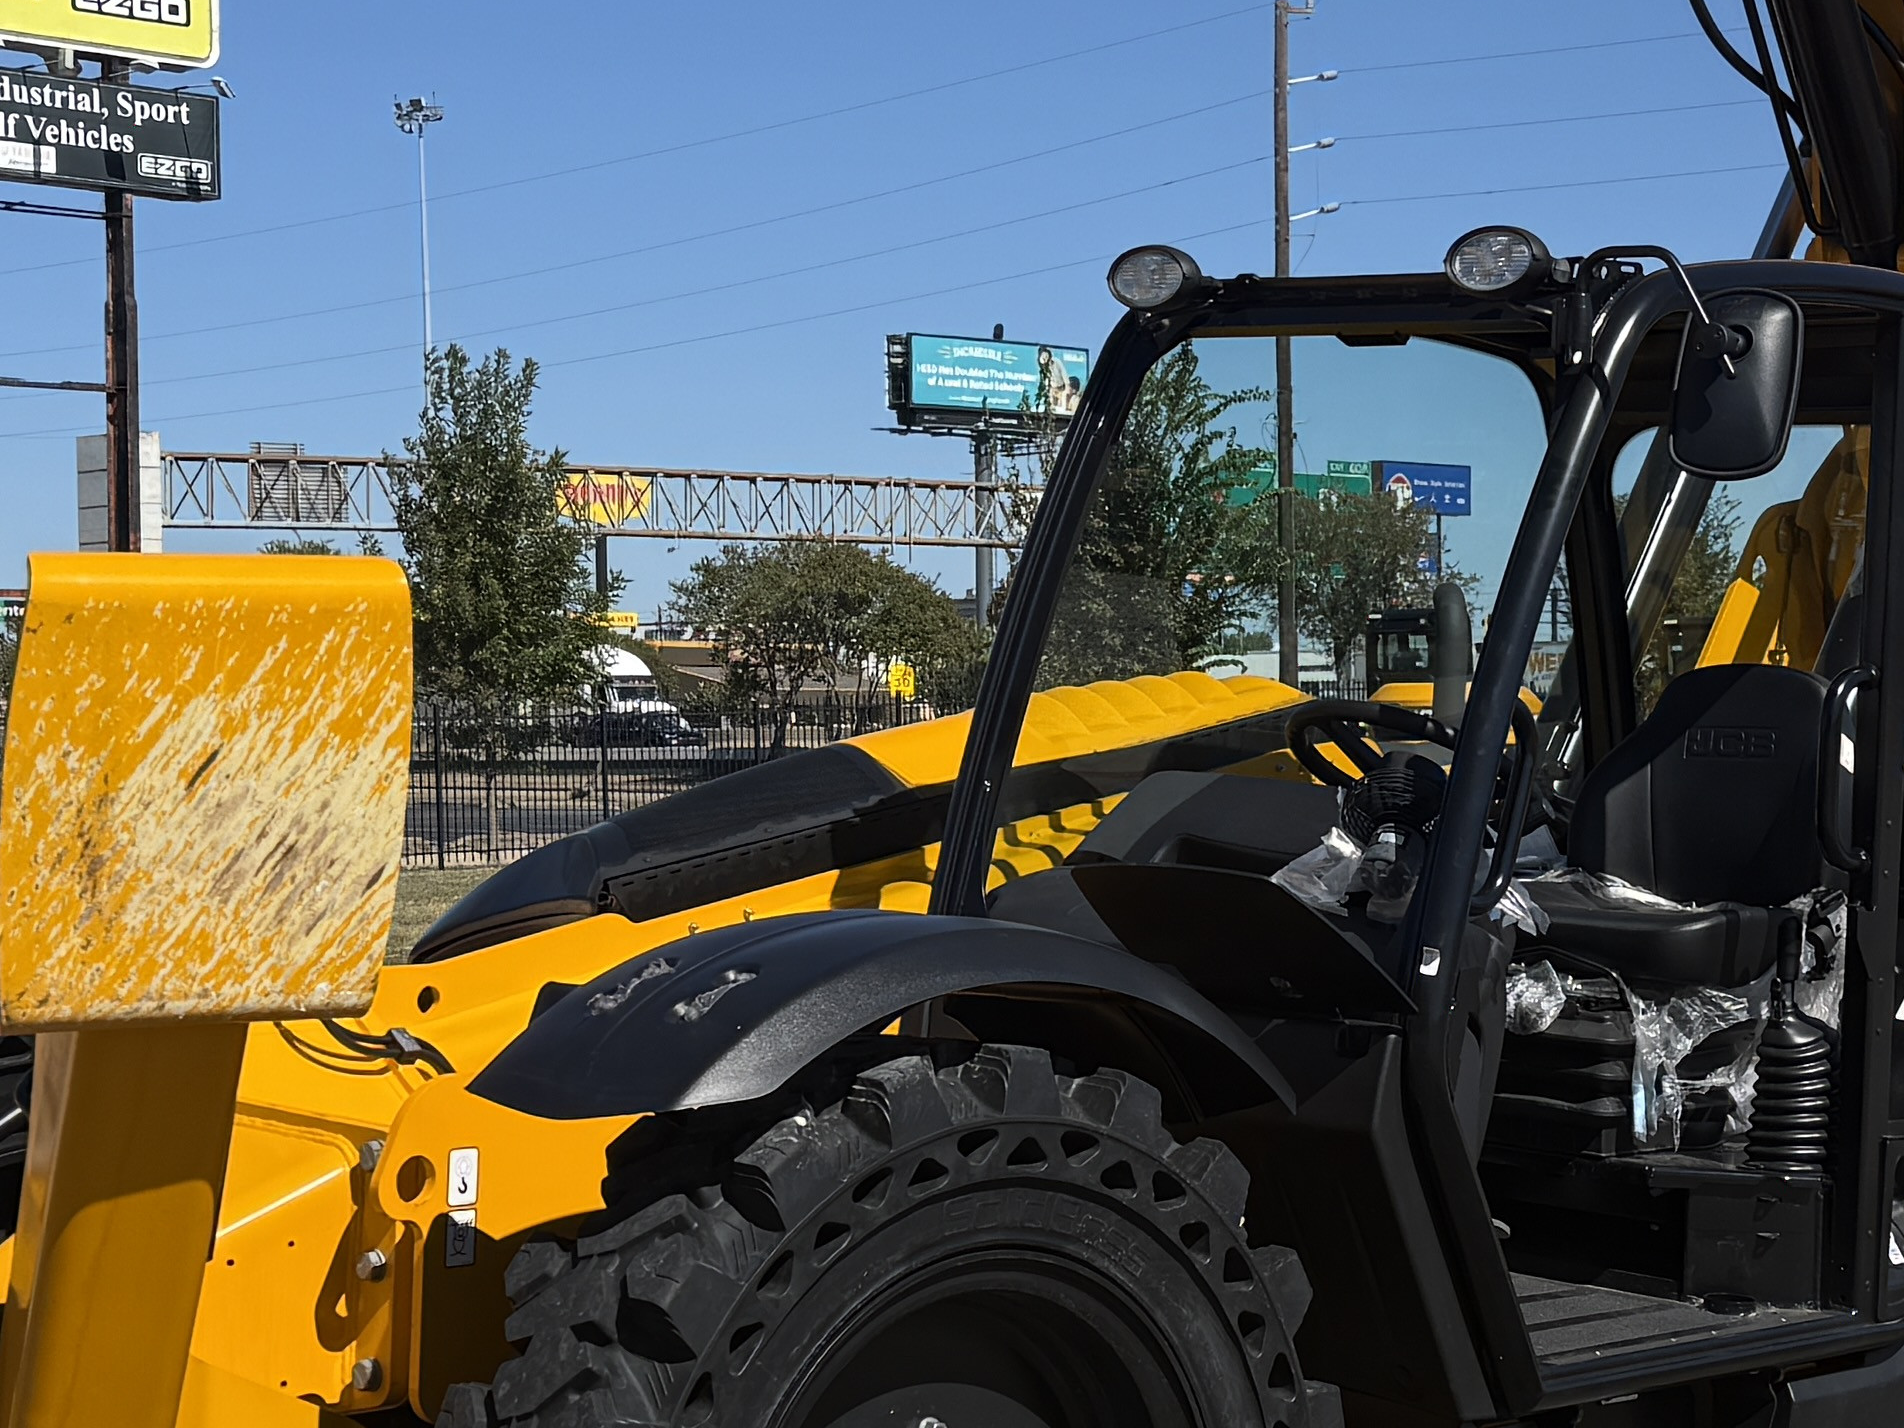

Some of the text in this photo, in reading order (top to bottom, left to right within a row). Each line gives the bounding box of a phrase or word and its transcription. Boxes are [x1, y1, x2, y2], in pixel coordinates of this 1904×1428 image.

[116, 92, 191, 127] Sport
[24, 115, 135, 154] Vehicles
[1693, 728, 1777, 758] JCB
